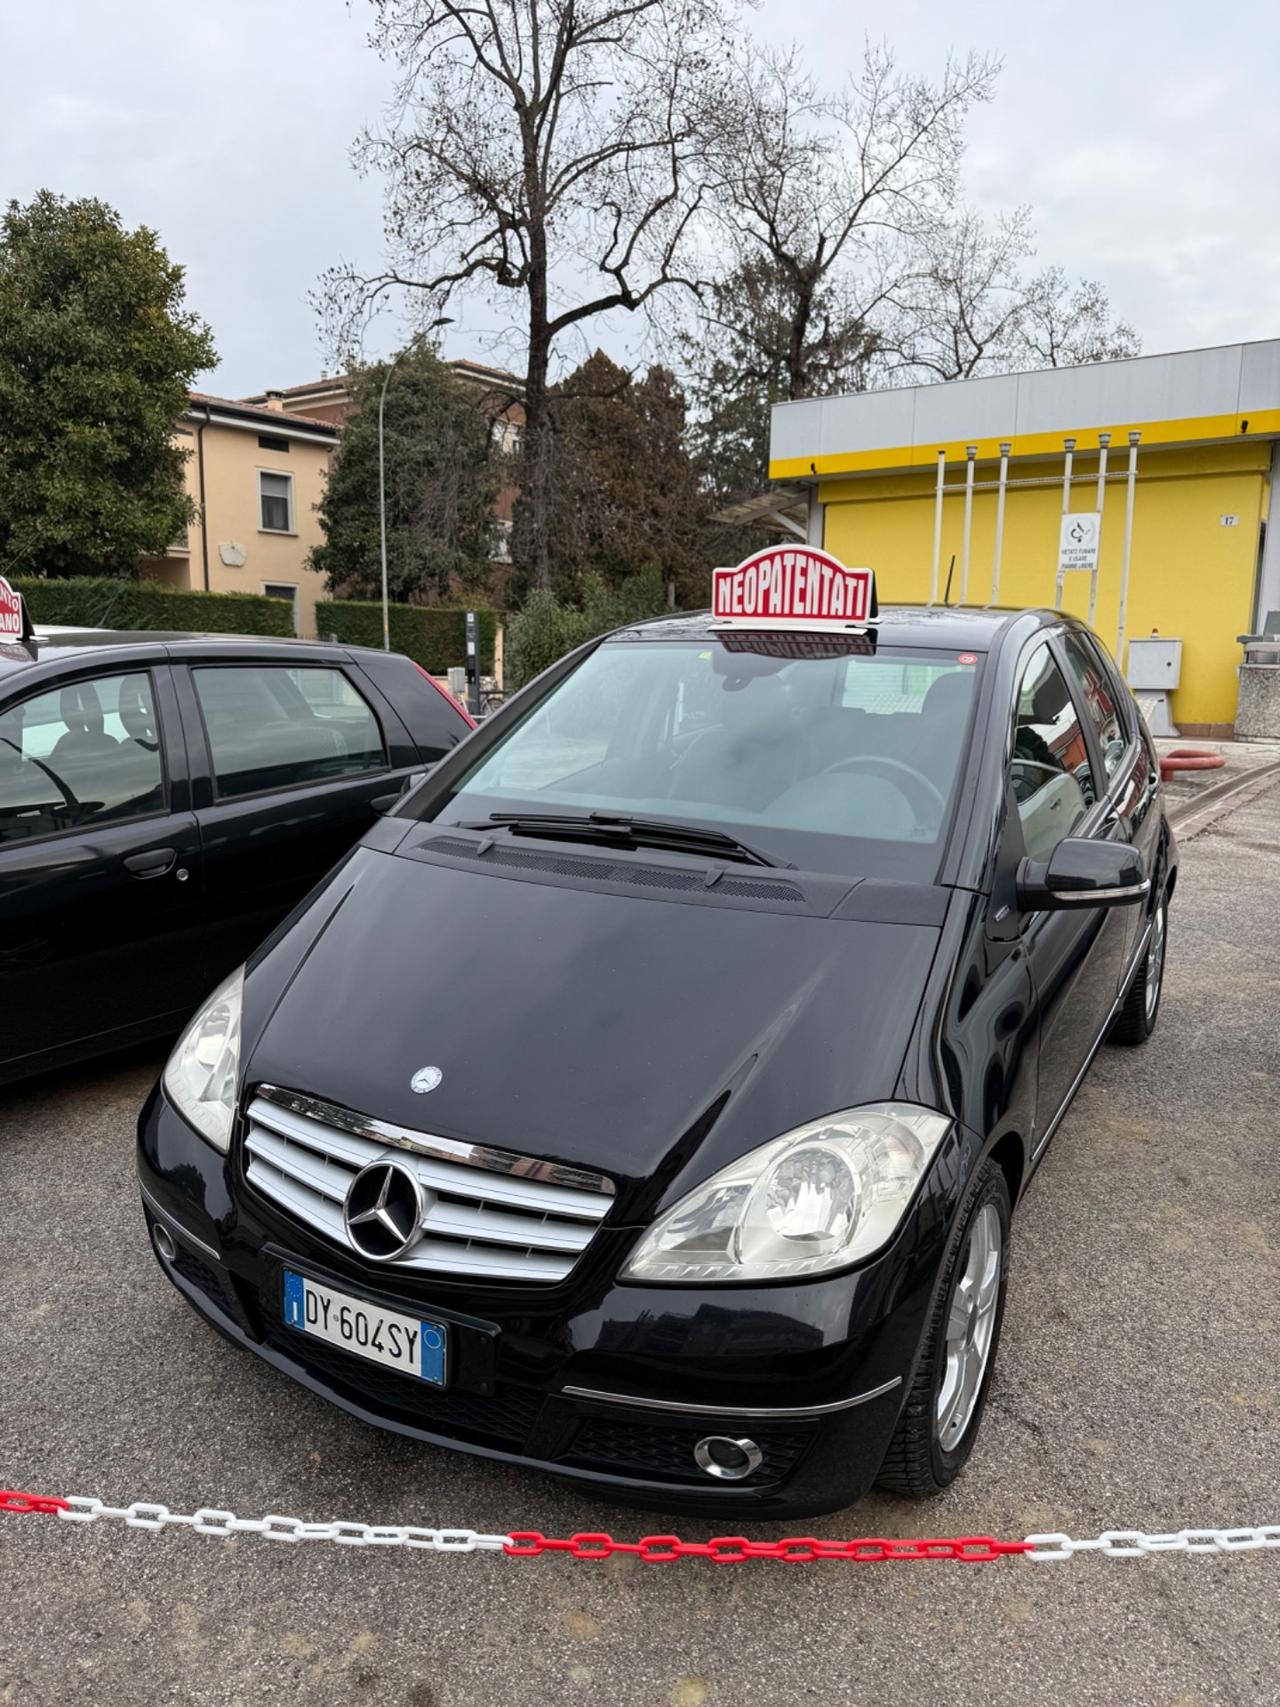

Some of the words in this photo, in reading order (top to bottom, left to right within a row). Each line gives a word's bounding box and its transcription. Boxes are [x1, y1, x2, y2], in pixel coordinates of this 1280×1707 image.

[1225, 516, 1234, 526] 17
[718, 553, 865, 617] NEOPATENTATI
[0, 612, 20, 632] ANO
